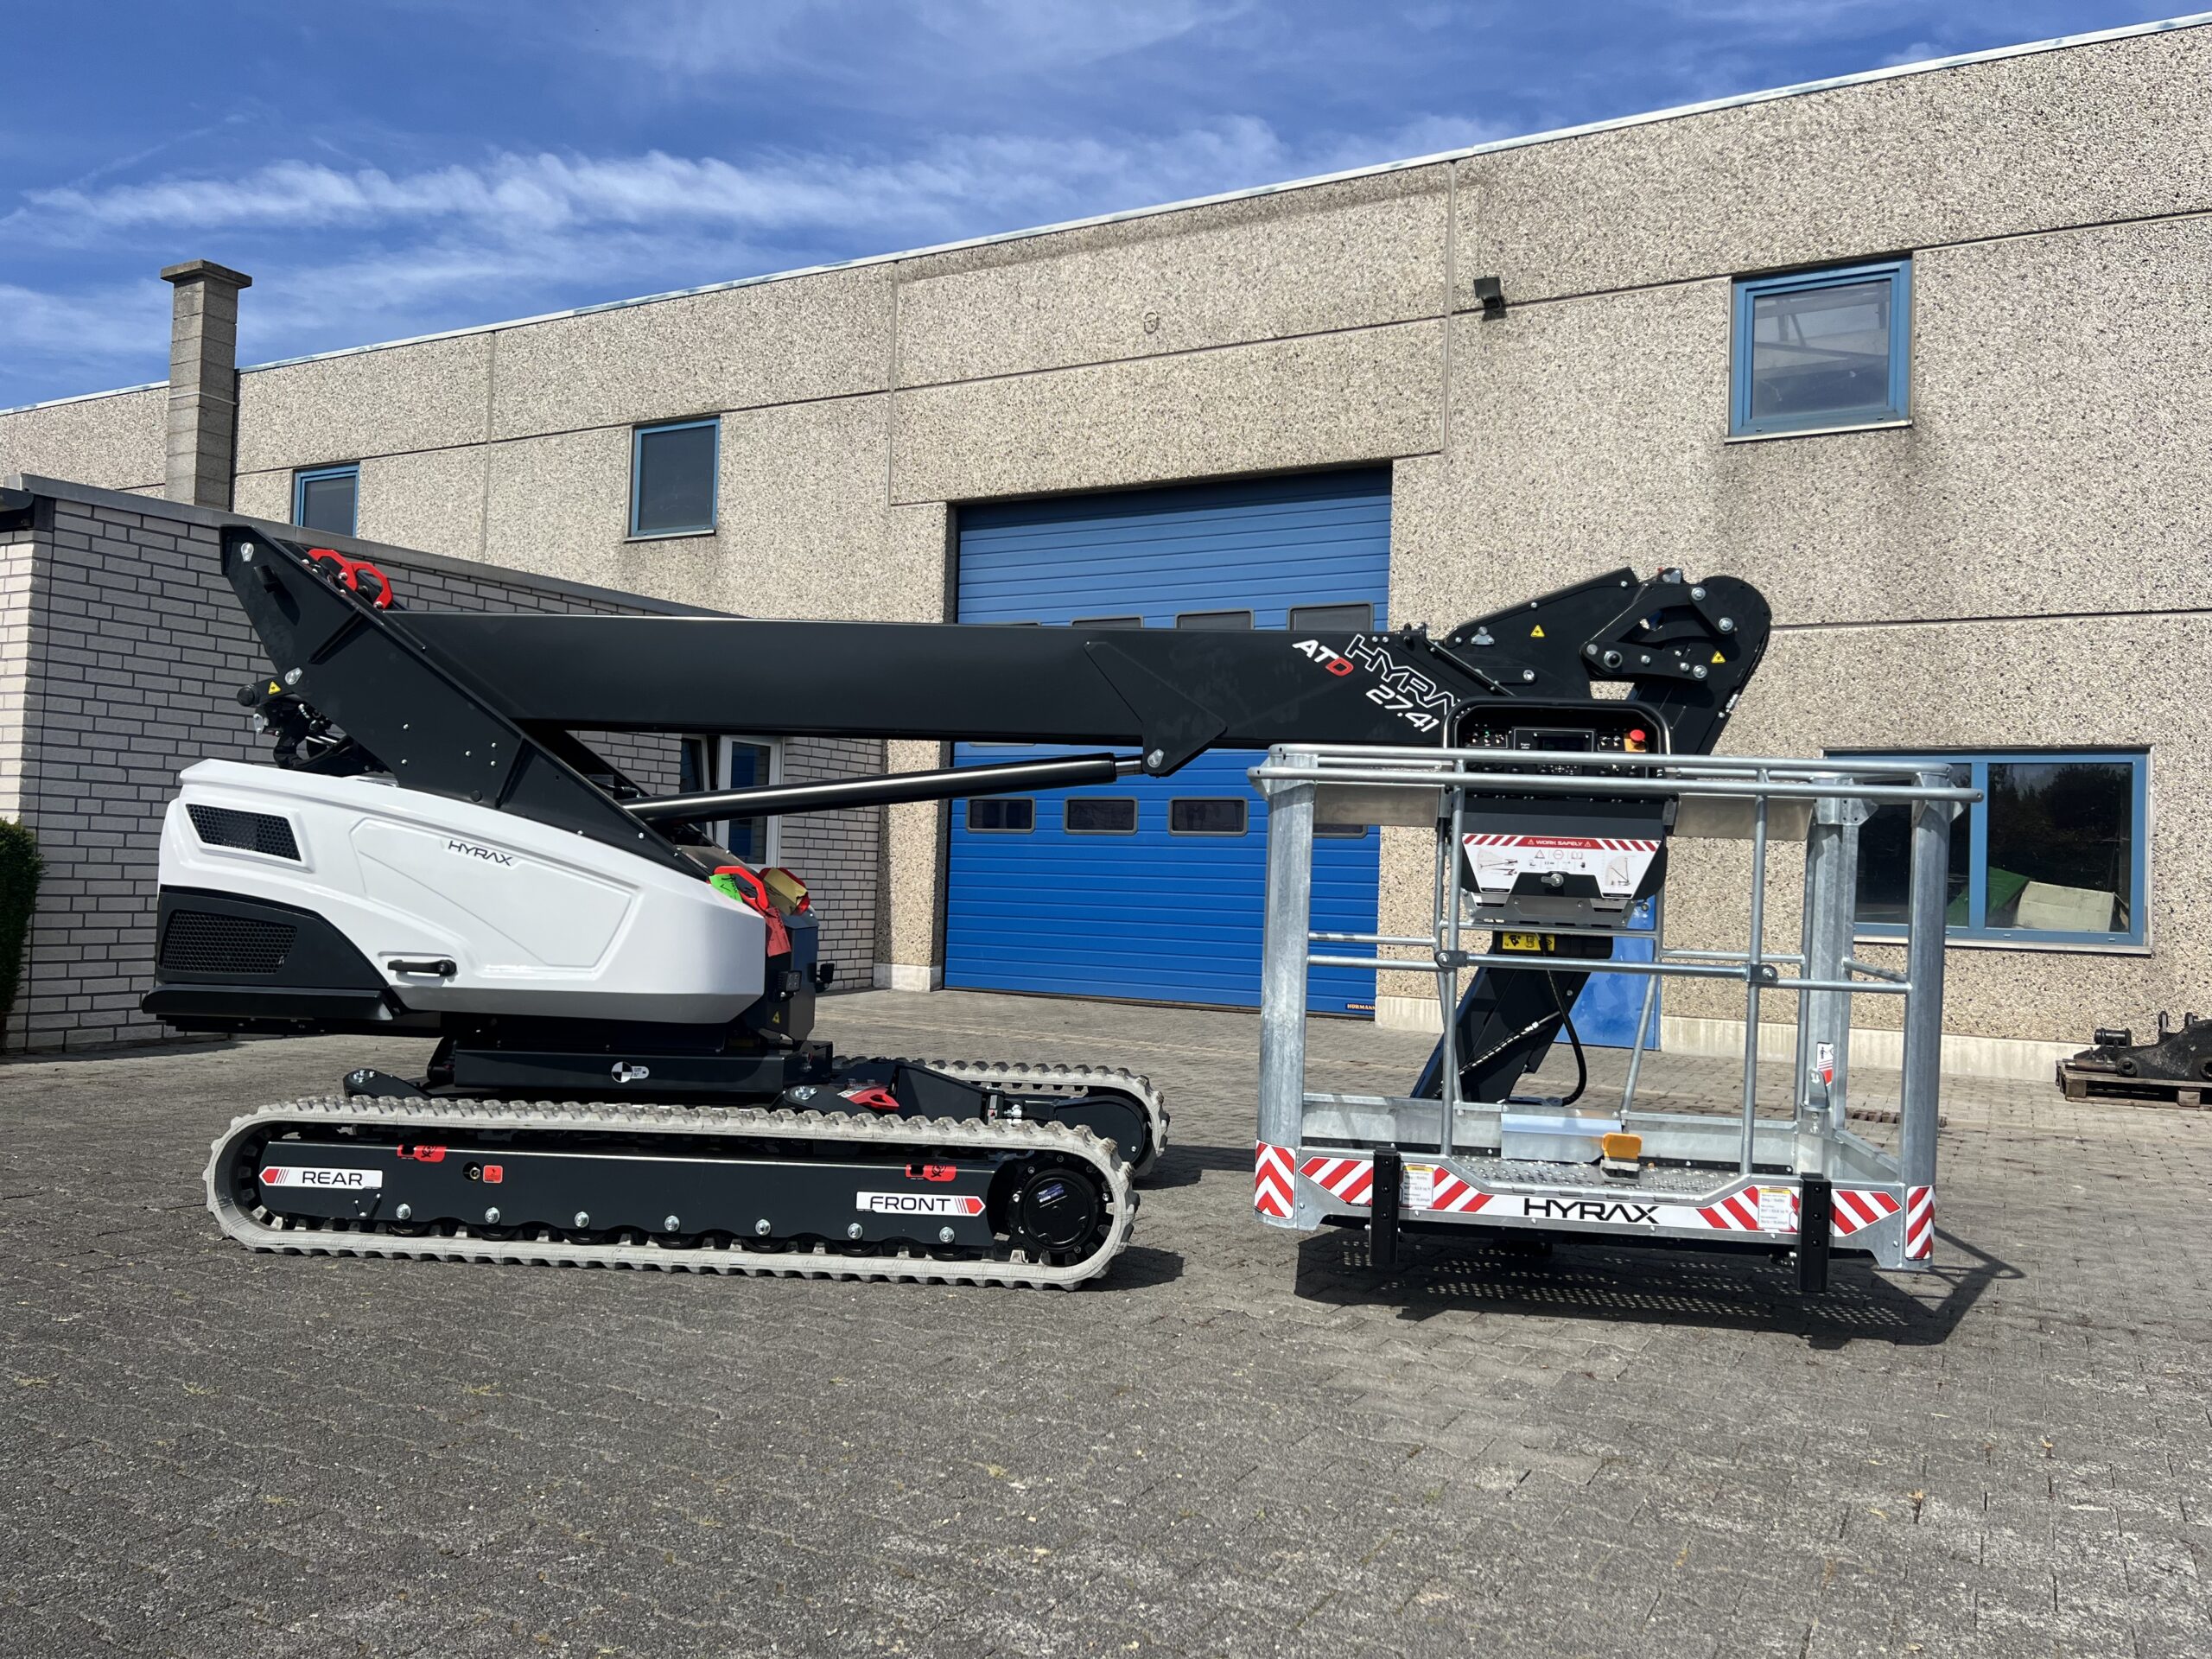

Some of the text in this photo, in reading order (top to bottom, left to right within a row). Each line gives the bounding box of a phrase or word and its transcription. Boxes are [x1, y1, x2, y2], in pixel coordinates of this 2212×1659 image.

[1344, 633, 1456, 716] HYRA
[1365, 684, 1440, 732] 27.41
[448, 840, 512, 866] HYRAX
[302, 1171, 363, 1185] REAR
[869, 1196, 951, 1212] FRONT
[1523, 1198, 1661, 1224] HYRAX
